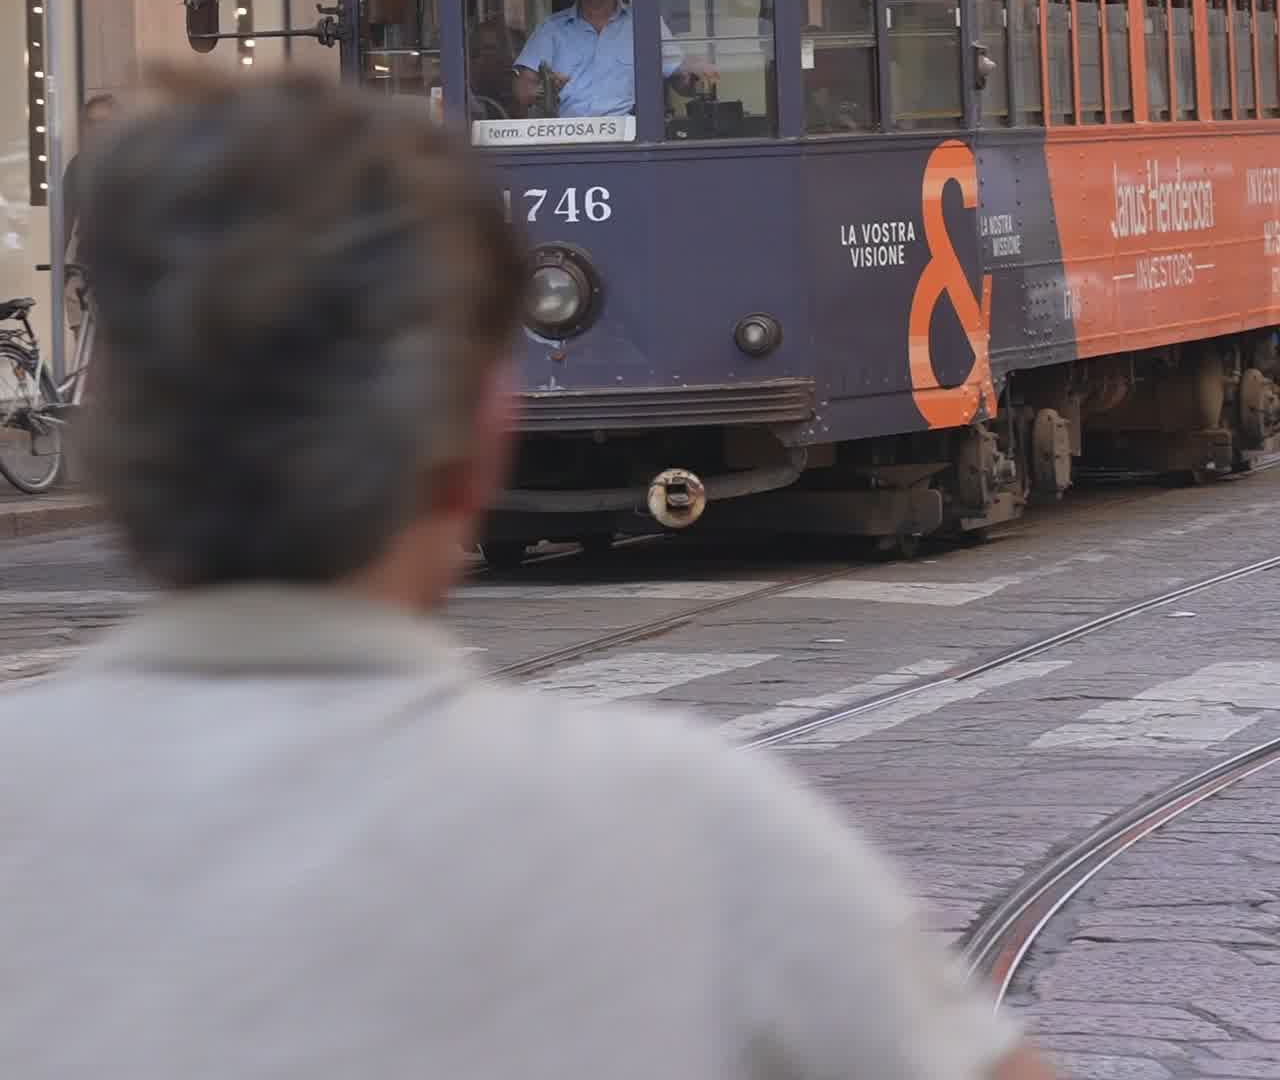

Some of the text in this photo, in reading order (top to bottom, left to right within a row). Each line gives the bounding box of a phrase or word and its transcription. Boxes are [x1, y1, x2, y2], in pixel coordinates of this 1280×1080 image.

[526, 124, 595, 138] CERTOSA
[598, 122, 617, 135] FS
[1111, 156, 1216, 240] Janus Henderson
[841, 221, 916, 246] LA VOSTRA
[850, 244, 905, 268] VISIONE
[1136, 252, 1194, 289] INVESTORS
